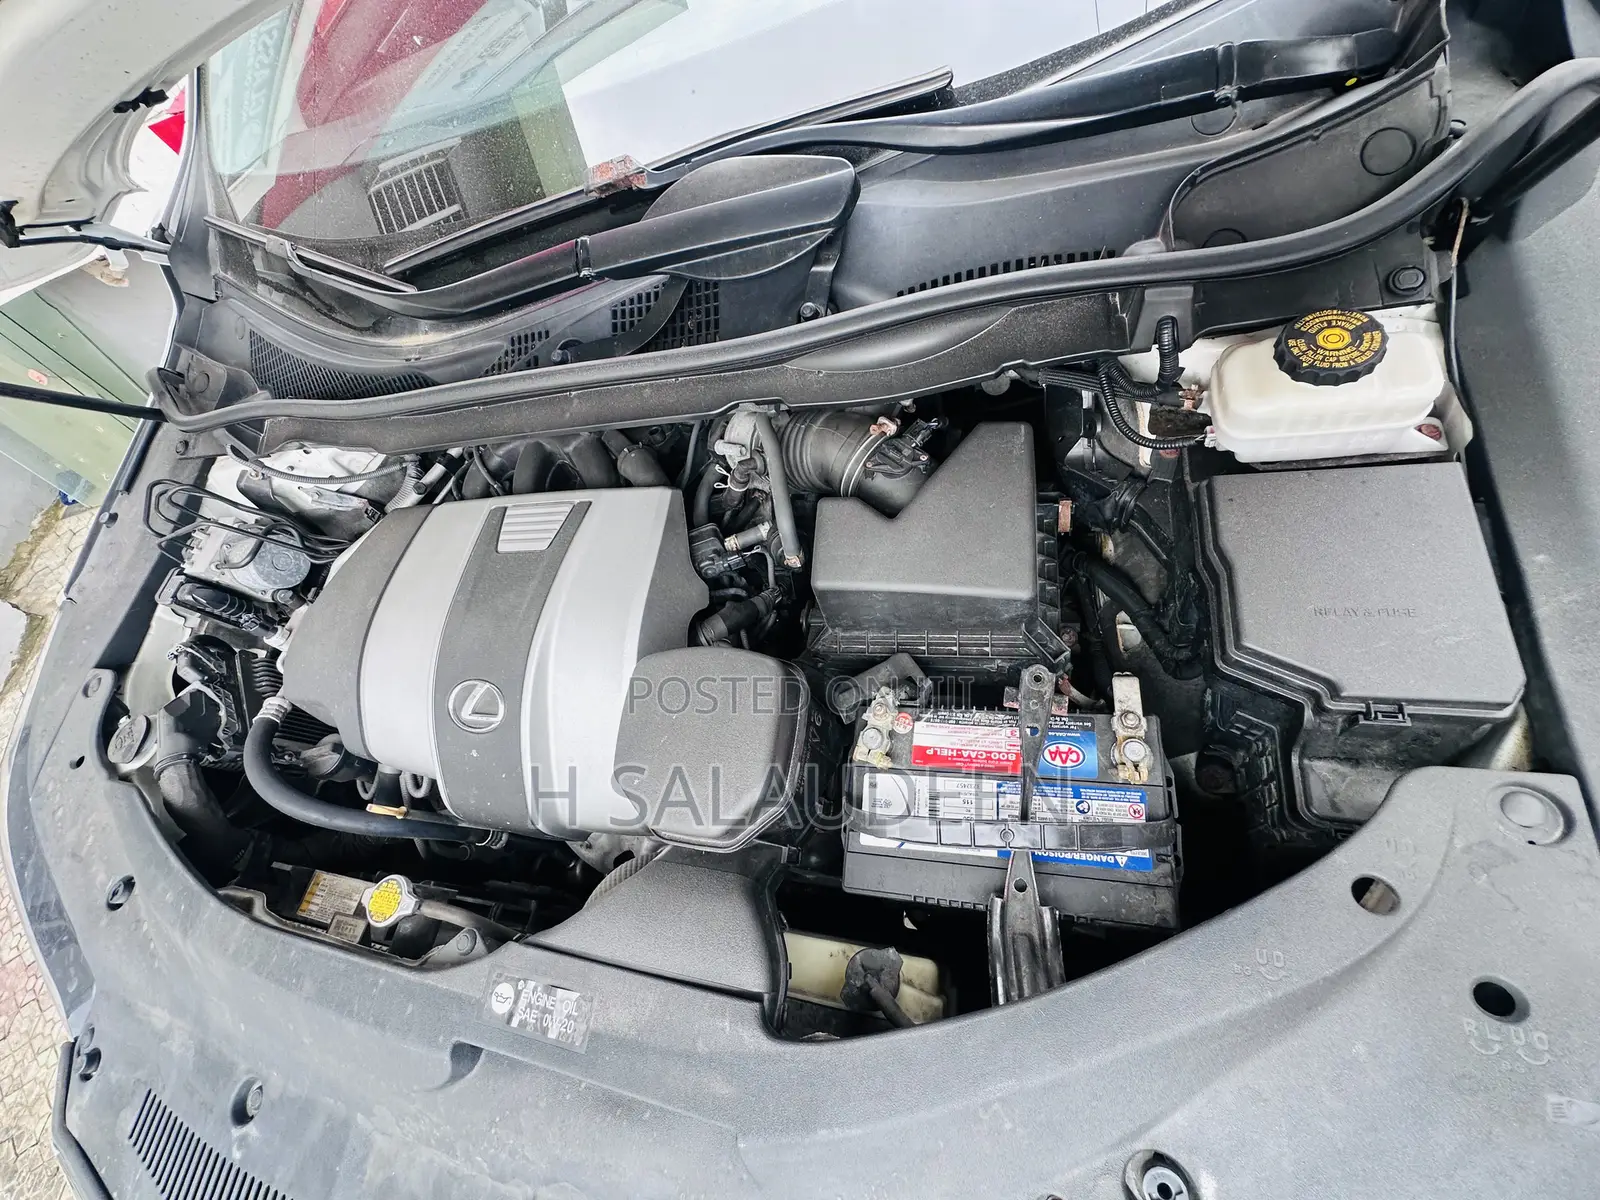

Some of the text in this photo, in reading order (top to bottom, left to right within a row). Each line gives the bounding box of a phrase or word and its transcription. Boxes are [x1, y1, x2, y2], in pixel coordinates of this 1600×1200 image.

[1308, 321, 1328, 334] FLUID
[1331, 320, 1357, 331] BRAKE
[1317, 346, 1357, 357] WARNING
[1313, 606, 1418, 618] RELAY & FUSE
[926, 747, 1016, 761] 800-CAA-HELP
[1047, 745, 1081, 766] CAA
[520, 988, 579, 1016] ENGINE OIL
[517, 1007, 538, 1024] SAE
